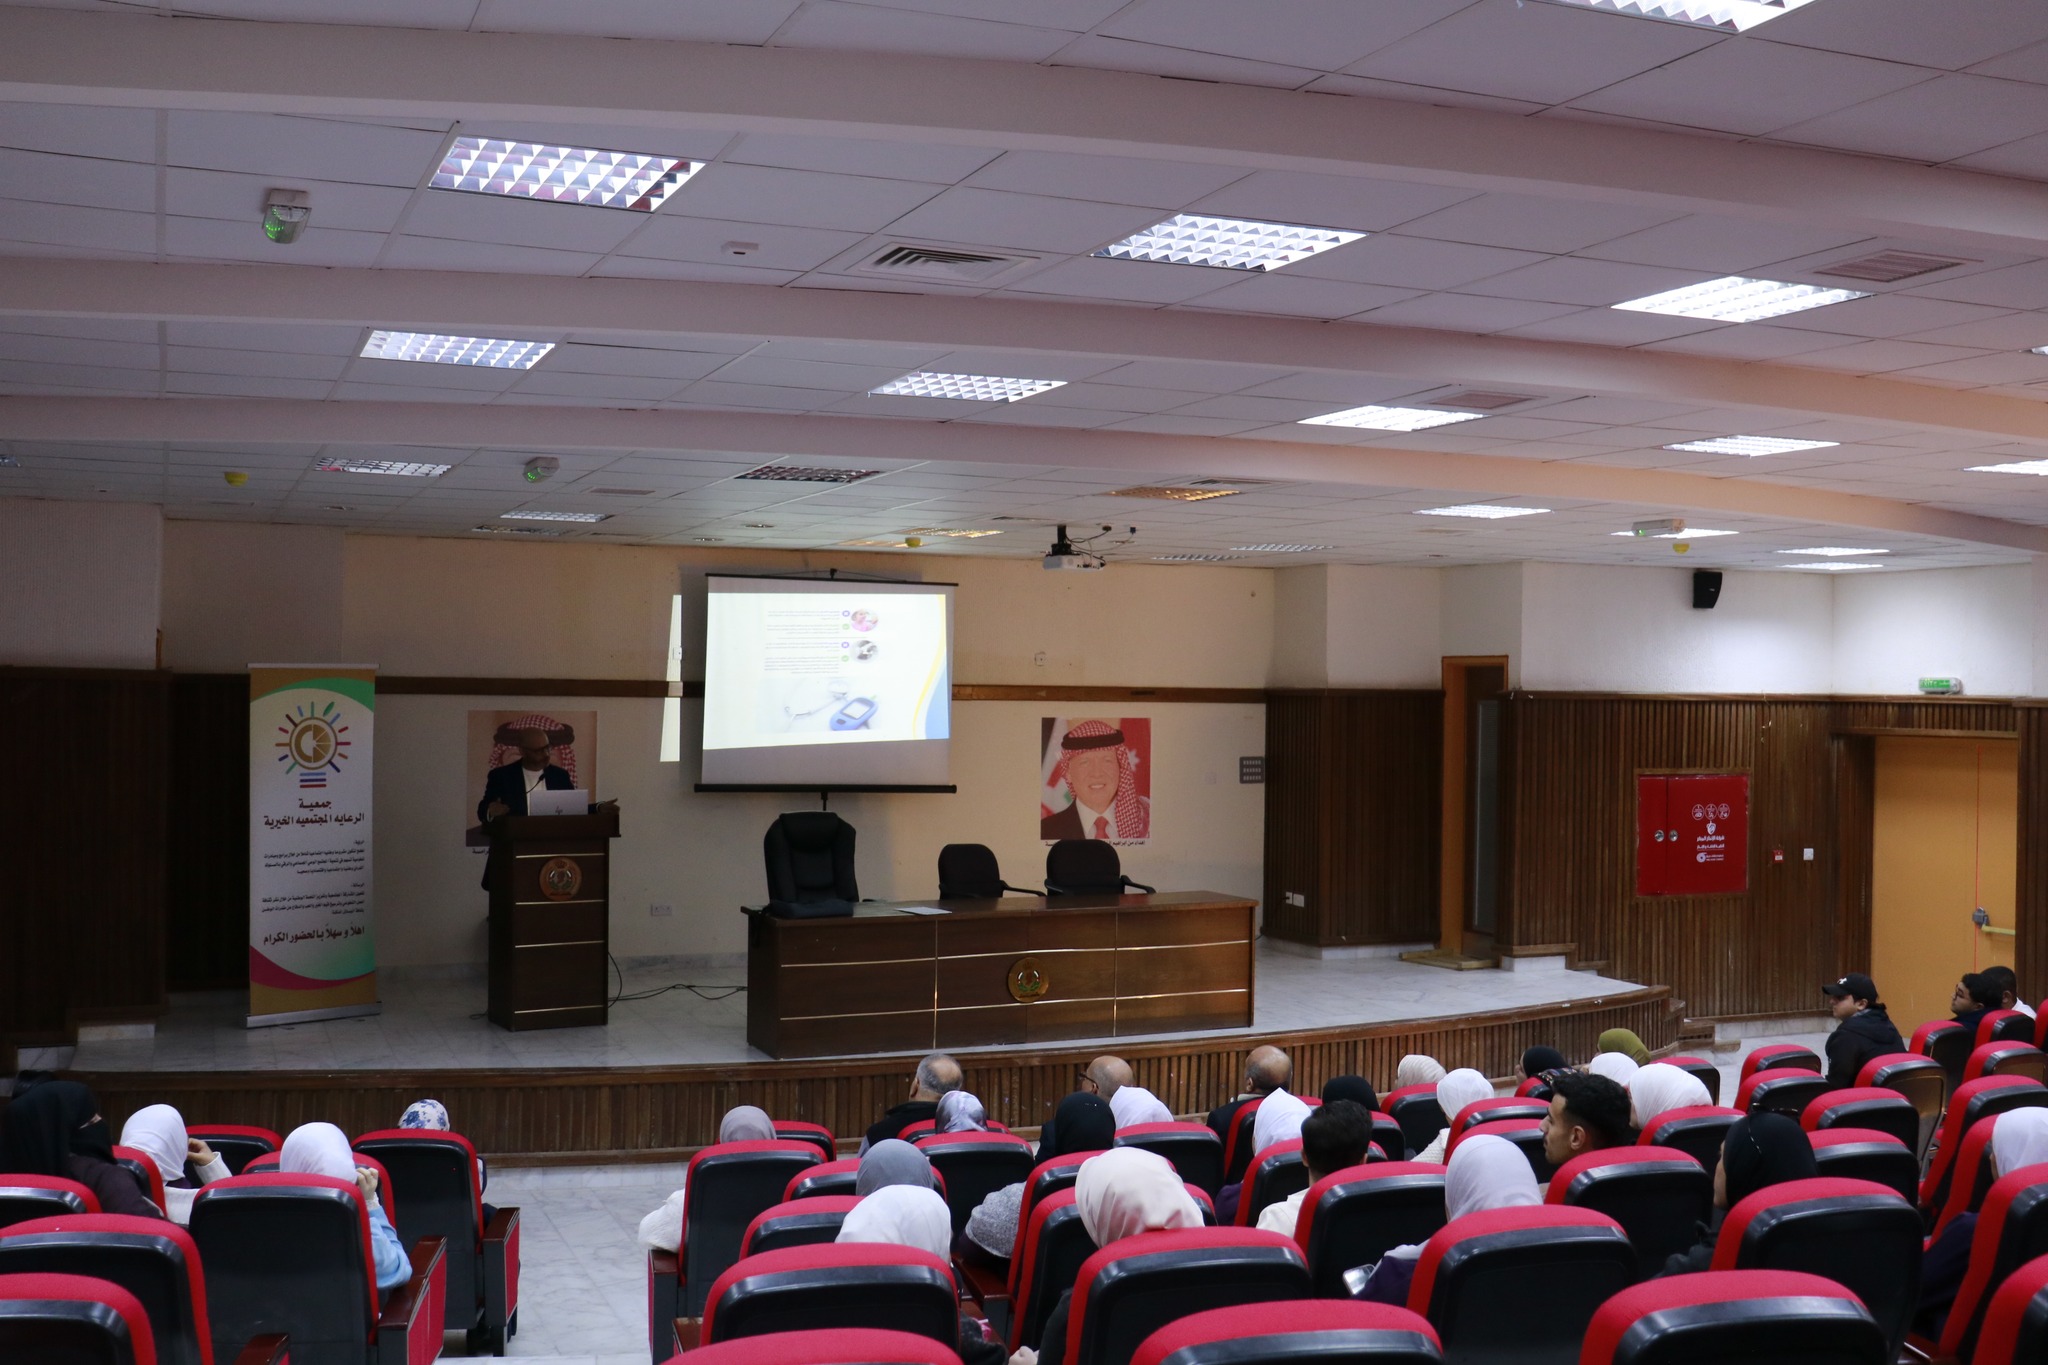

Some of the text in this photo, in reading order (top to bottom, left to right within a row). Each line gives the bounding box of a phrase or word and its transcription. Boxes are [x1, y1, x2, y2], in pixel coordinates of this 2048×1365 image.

[299, 799, 331, 811] جمعية
[264, 815, 294, 829] الخيرية
[296, 814, 332, 827] المجتمعيه
[263, 932, 289, 945] الكرام
[289, 929, 325, 944] بالحضور
